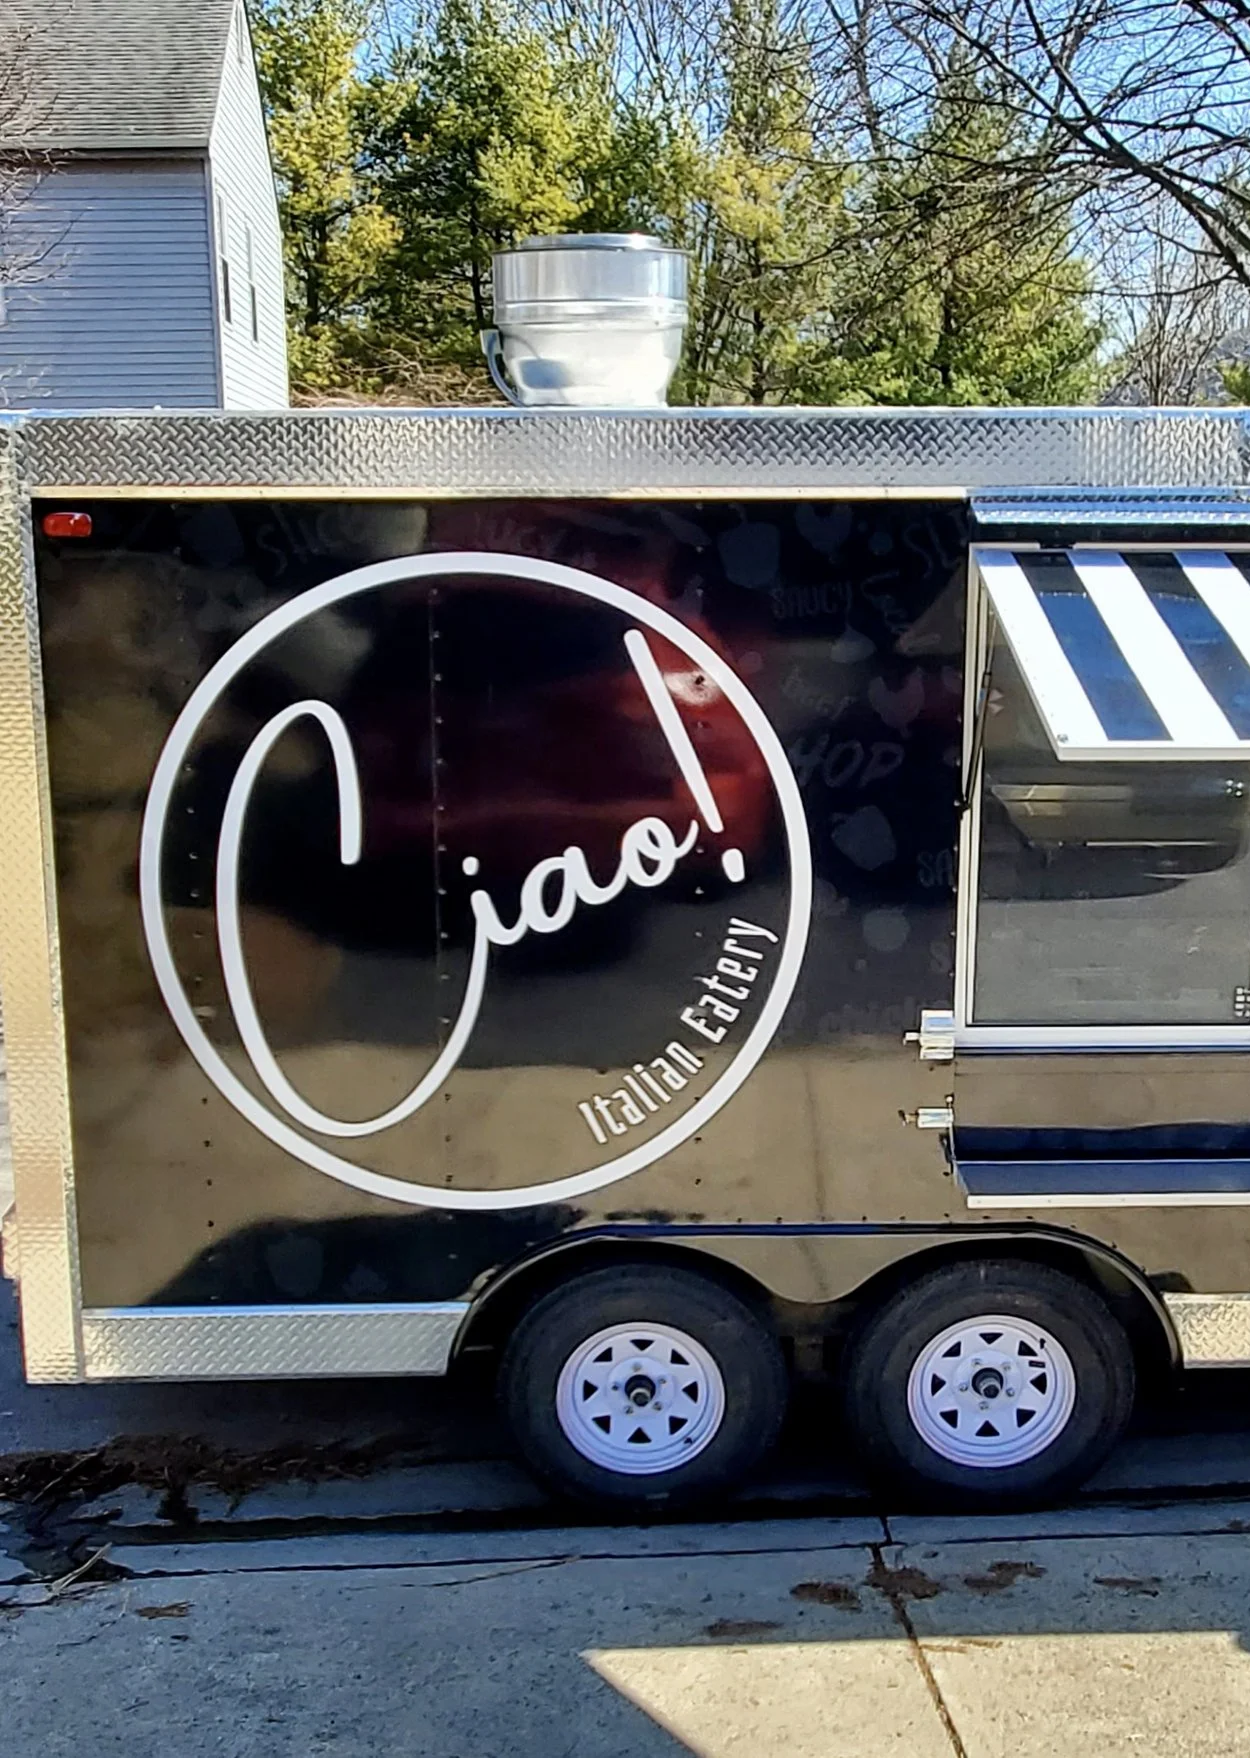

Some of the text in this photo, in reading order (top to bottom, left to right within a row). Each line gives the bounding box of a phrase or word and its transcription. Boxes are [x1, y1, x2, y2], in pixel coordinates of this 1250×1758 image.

[217, 629, 745, 1137] Ciao!
[578, 917, 779, 1144] Italian Eatery
